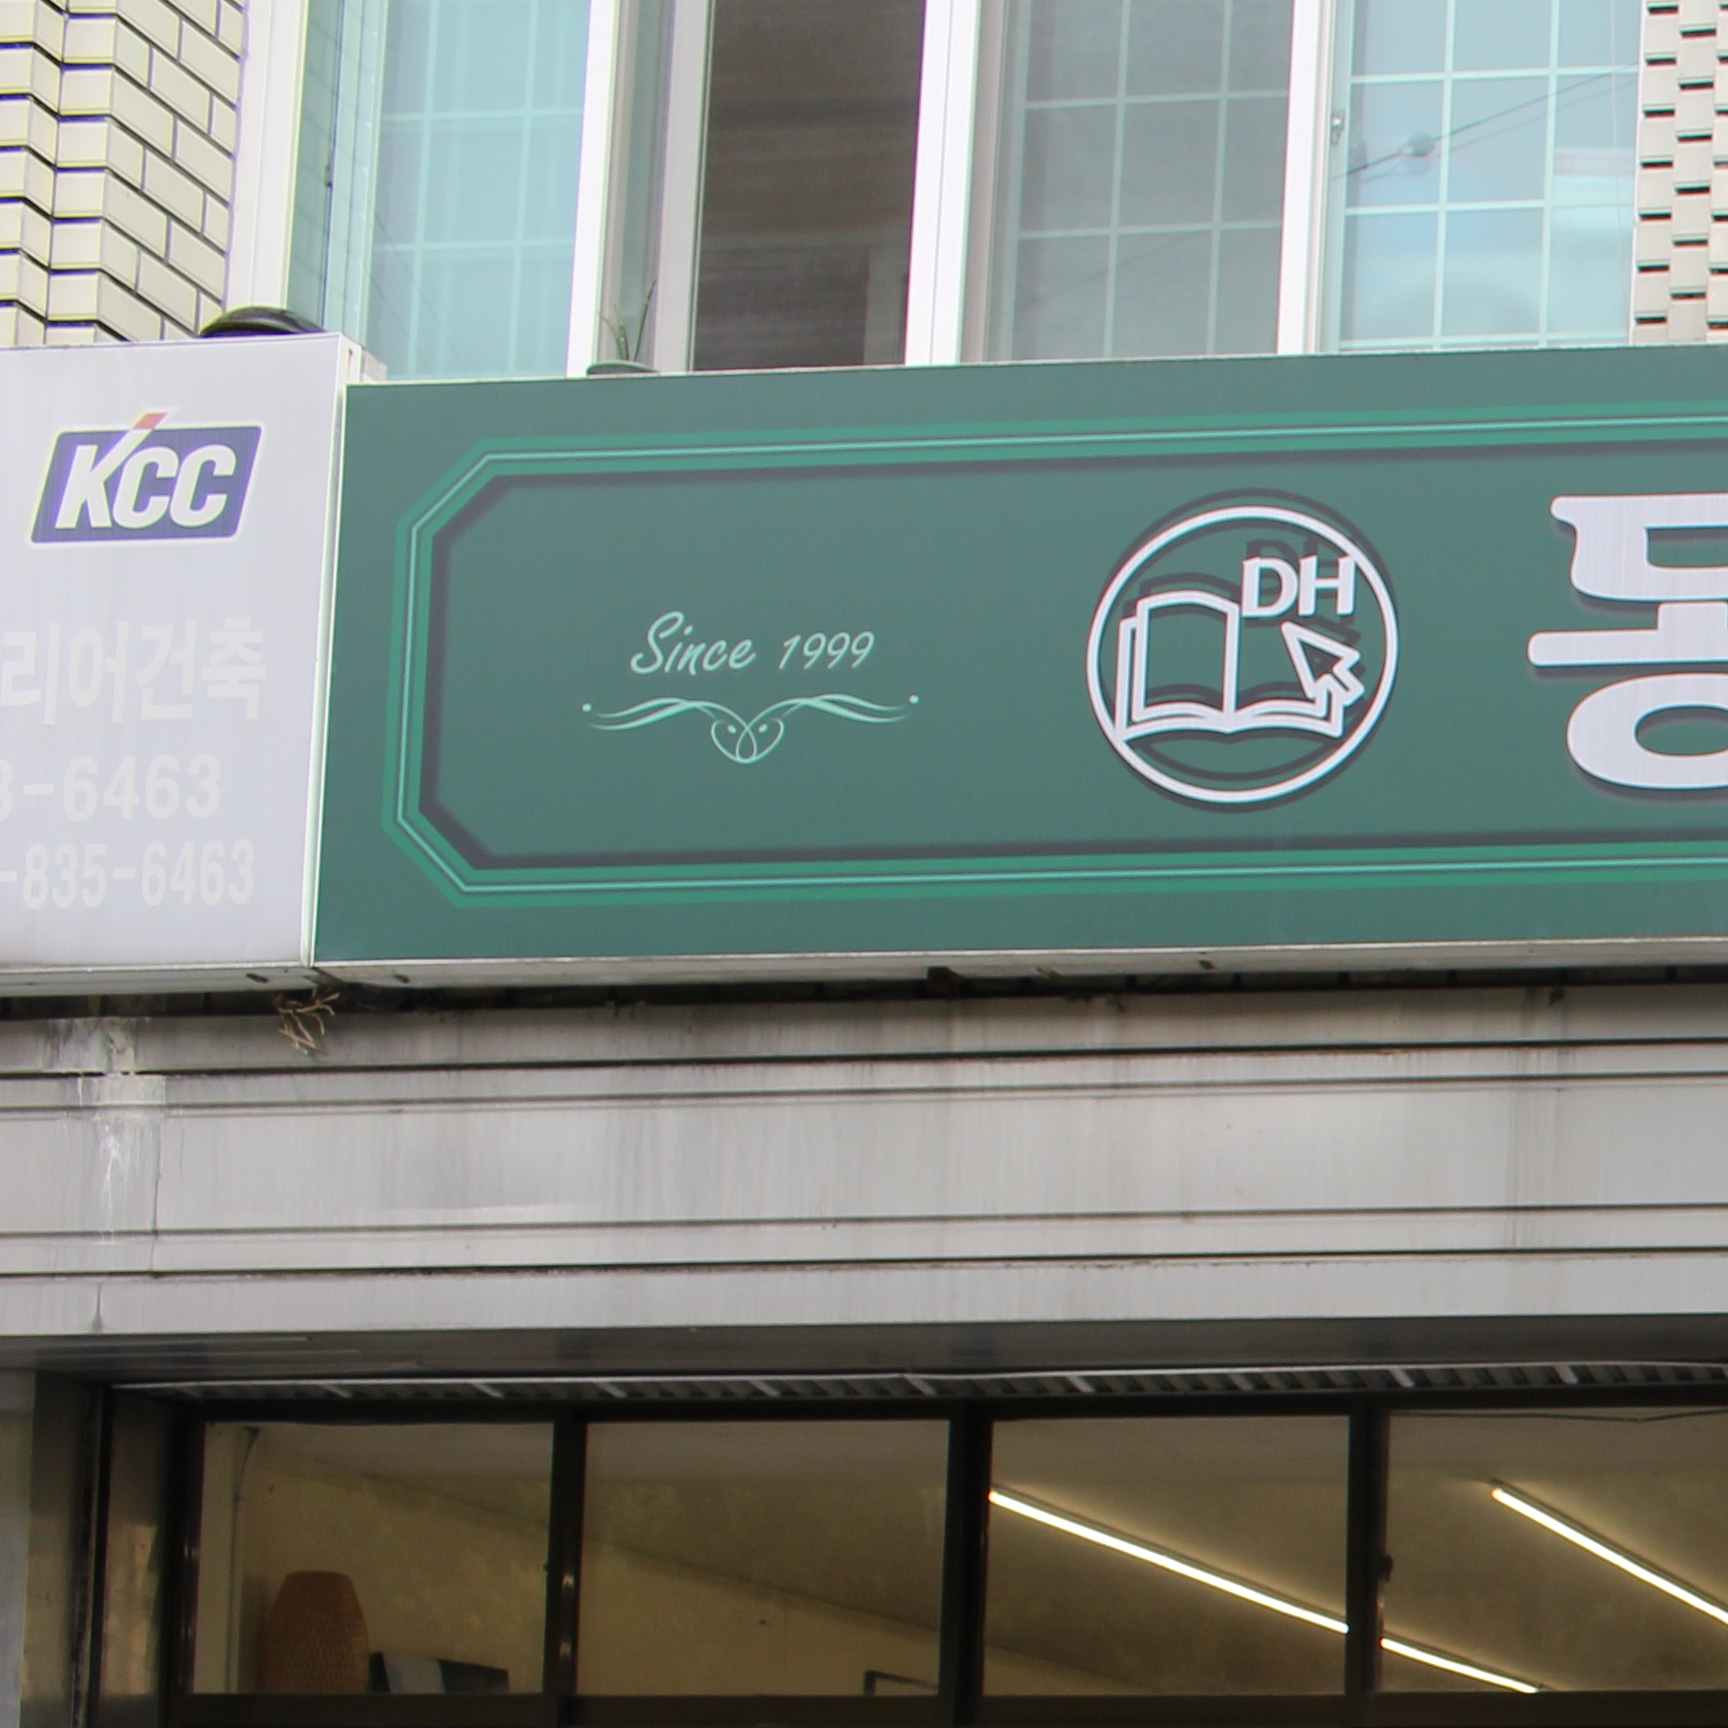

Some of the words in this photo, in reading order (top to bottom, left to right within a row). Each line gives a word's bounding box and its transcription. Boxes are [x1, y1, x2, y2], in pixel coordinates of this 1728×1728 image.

[54, 412, 237, 530] KCC
[1241, 555, 1355, 617] DH
[630, 611, 757, 675] Since
[776, 630, 877, 671] 1999
